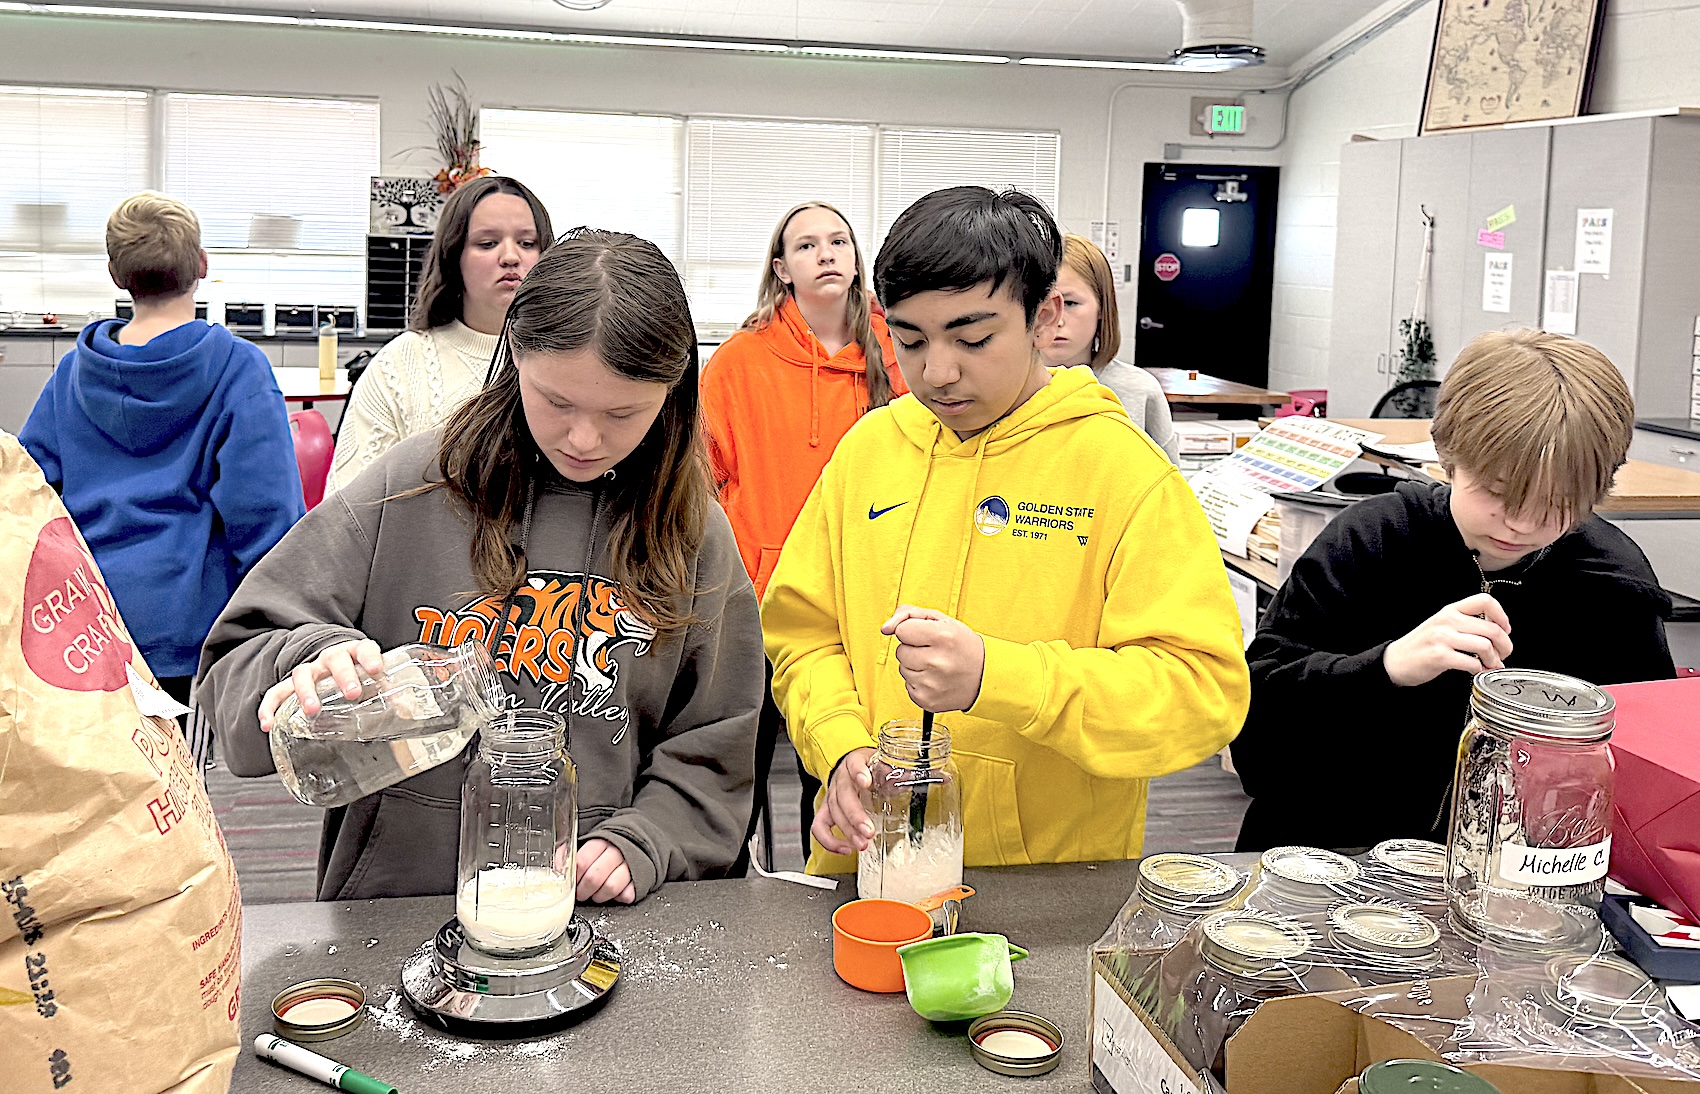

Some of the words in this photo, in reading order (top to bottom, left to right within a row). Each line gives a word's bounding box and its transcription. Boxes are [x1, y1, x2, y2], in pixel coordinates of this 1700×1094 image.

[1212, 105, 1245, 131] EXIT
[1156, 262, 1179, 272] STOP
[1017, 501, 1064, 516] GOLDEN
[1065, 506, 1095, 519] STATE
[1015, 514, 1075, 531] WARRIORS
[1012, 528, 1028, 538] EST.
[1031, 531, 1048, 541] 1971
[413, 606, 574, 685] TIGERS
[1519, 852, 1587, 875] Michelle
